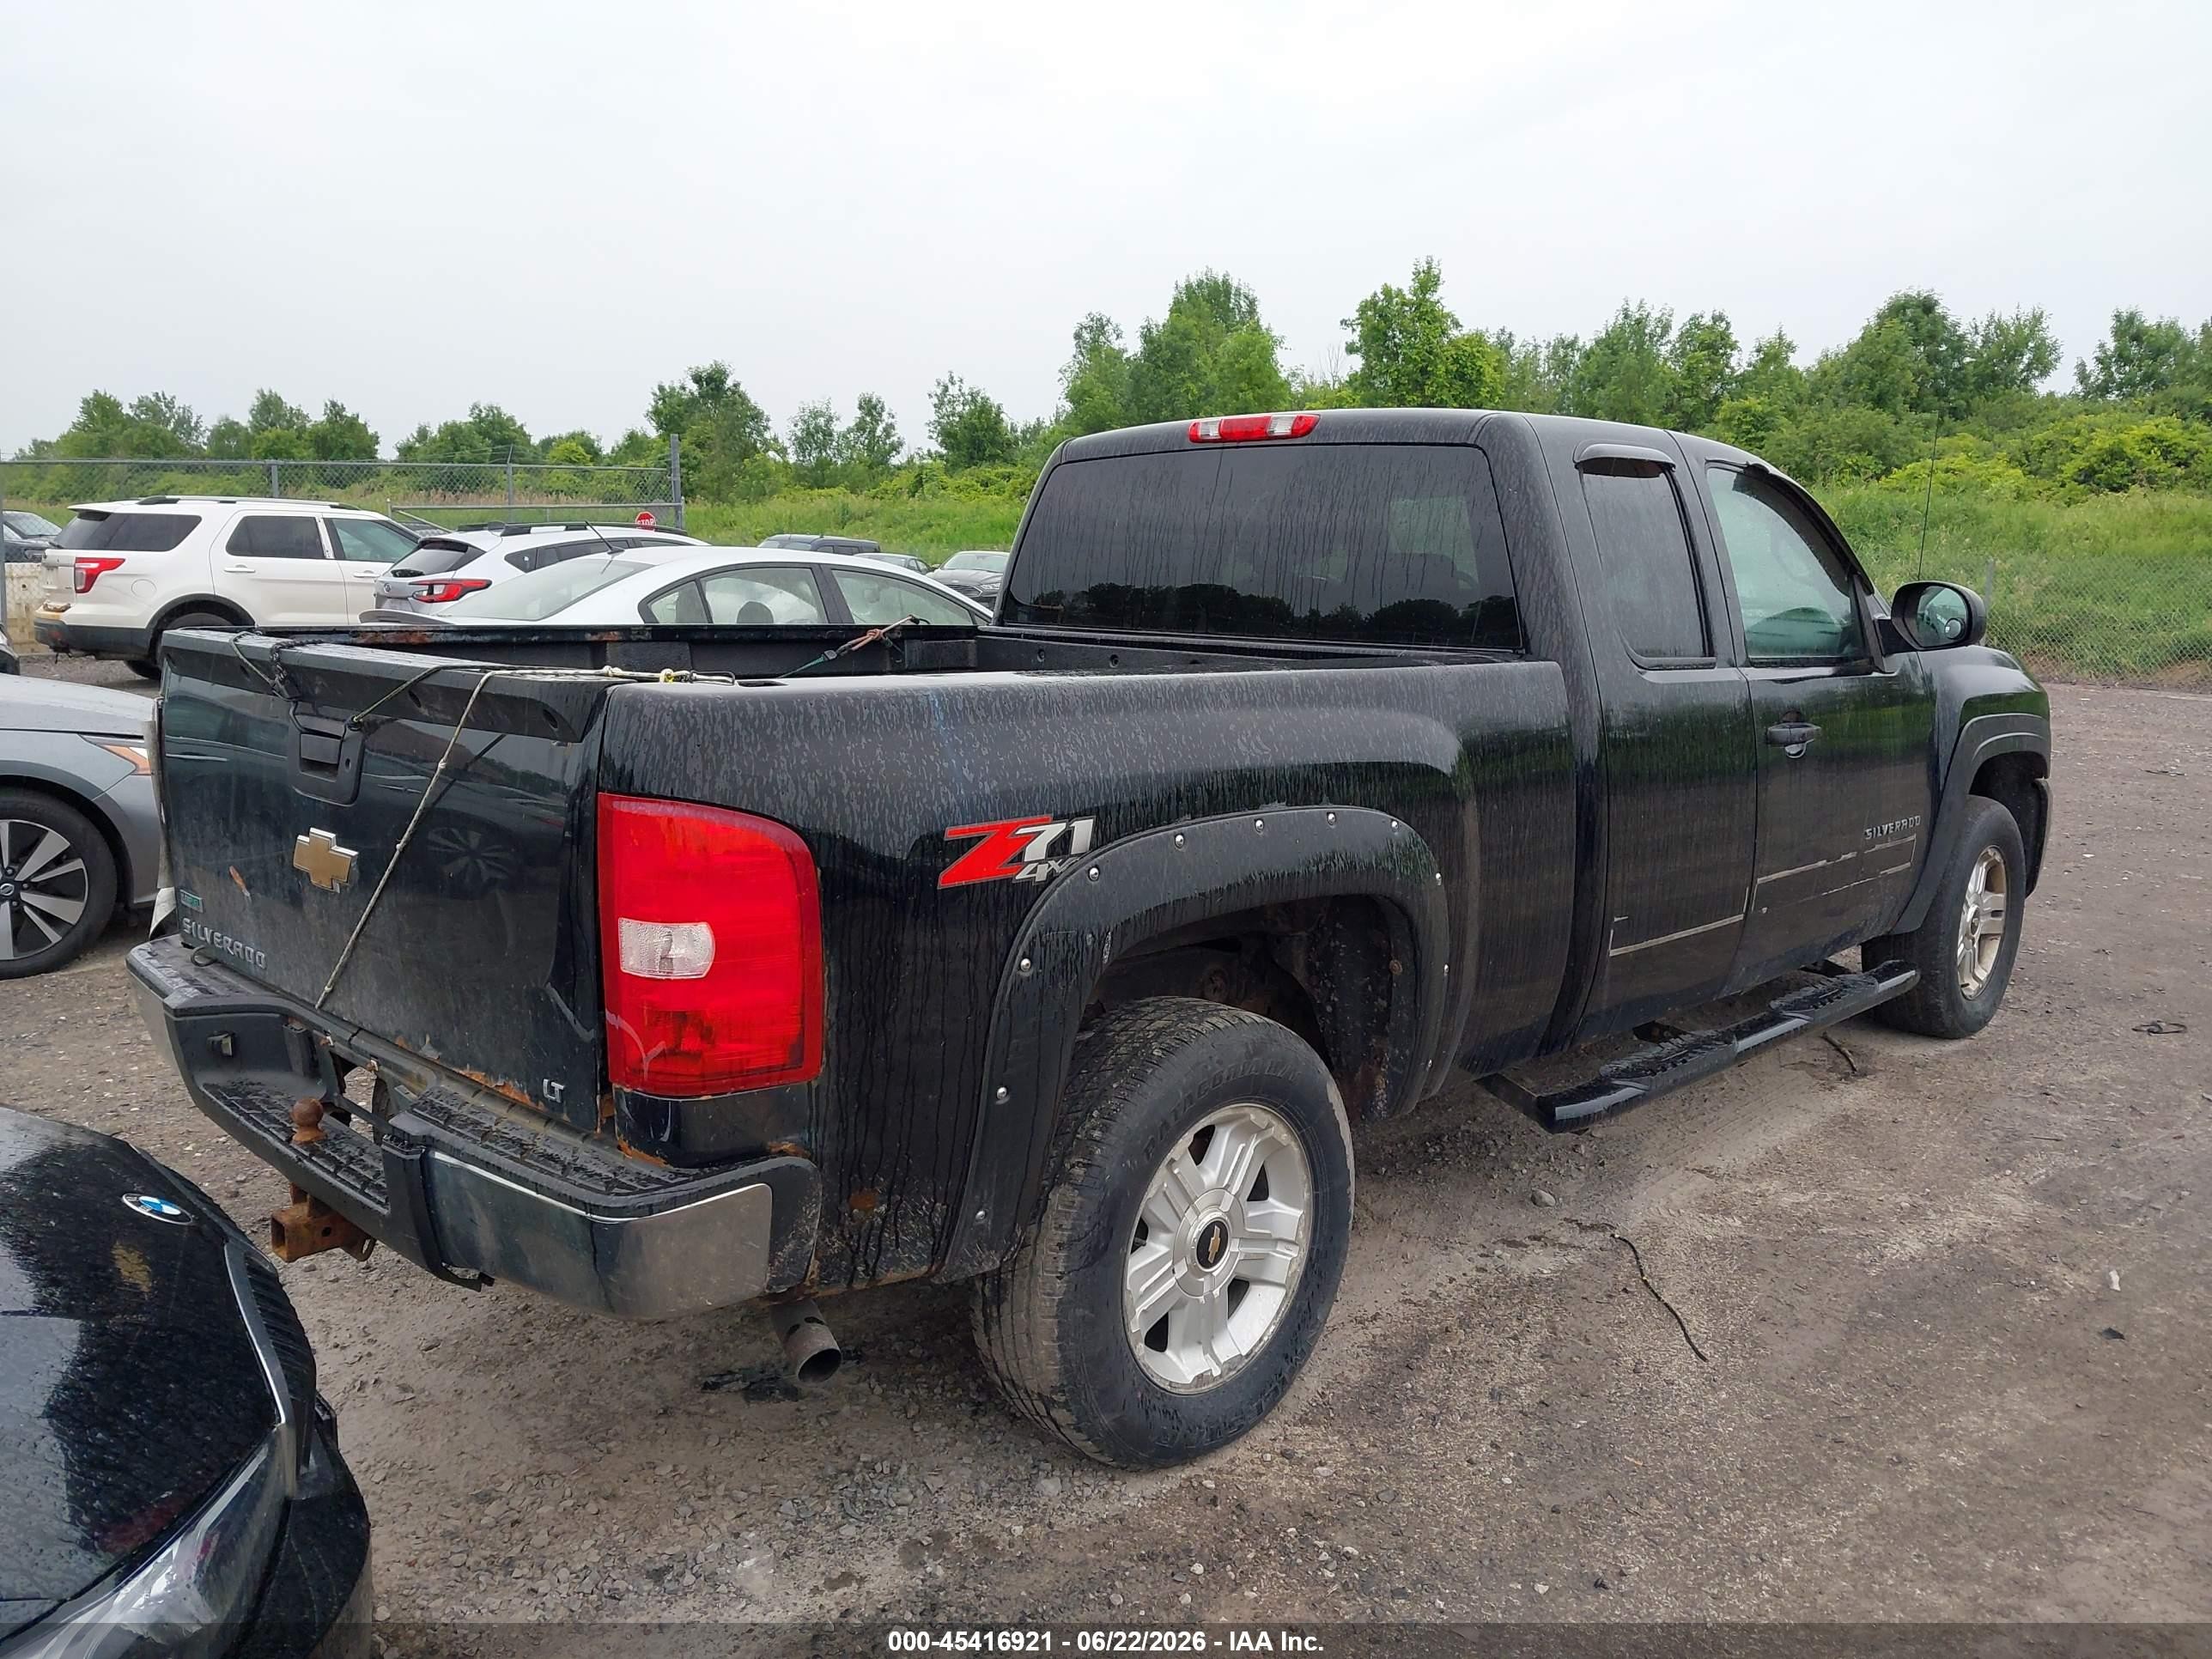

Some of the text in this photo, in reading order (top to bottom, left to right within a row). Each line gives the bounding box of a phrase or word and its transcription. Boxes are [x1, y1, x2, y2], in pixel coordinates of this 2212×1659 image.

[1864, 815, 1921, 840] SILVERADO
[938, 814, 1097, 890] Z71
[182, 917, 267, 969] SILVERADO
[543, 1079, 564, 1103] LT
